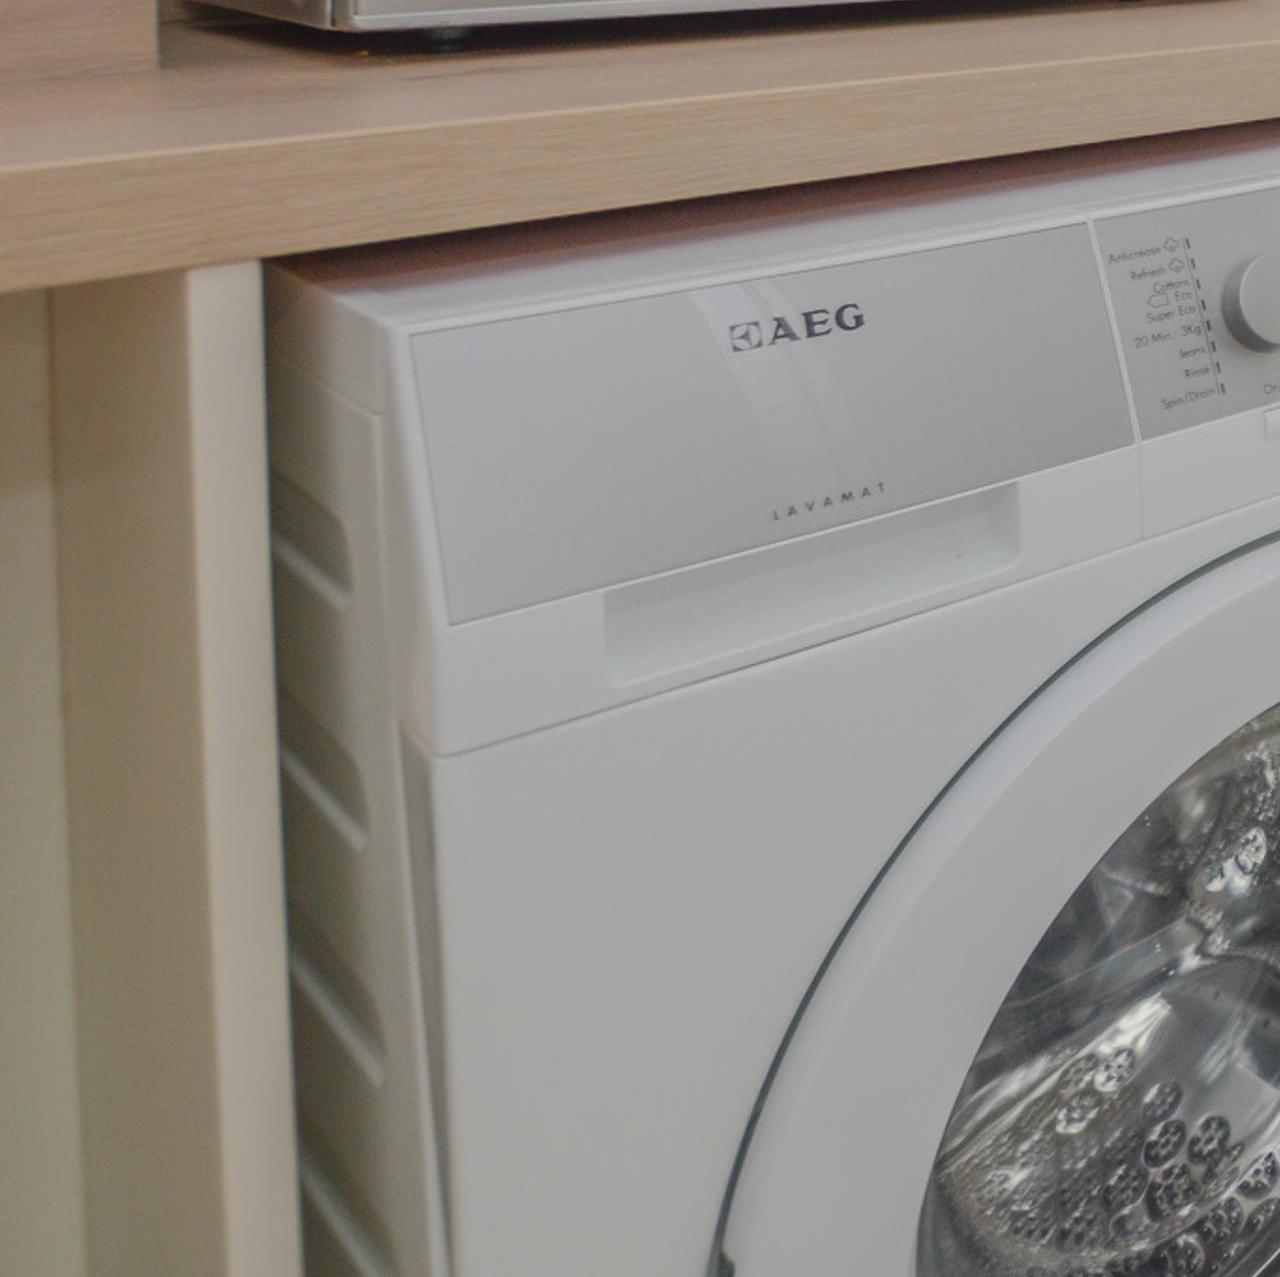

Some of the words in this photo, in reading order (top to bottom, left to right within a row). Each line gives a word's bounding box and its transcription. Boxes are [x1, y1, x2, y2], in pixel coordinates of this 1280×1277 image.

[1174, 290, 1194, 301] Eco
[1177, 305, 1197, 316] Eco
[768, 303, 867, 346] AEG
[772, 482, 886, 522] LAVAMAT
